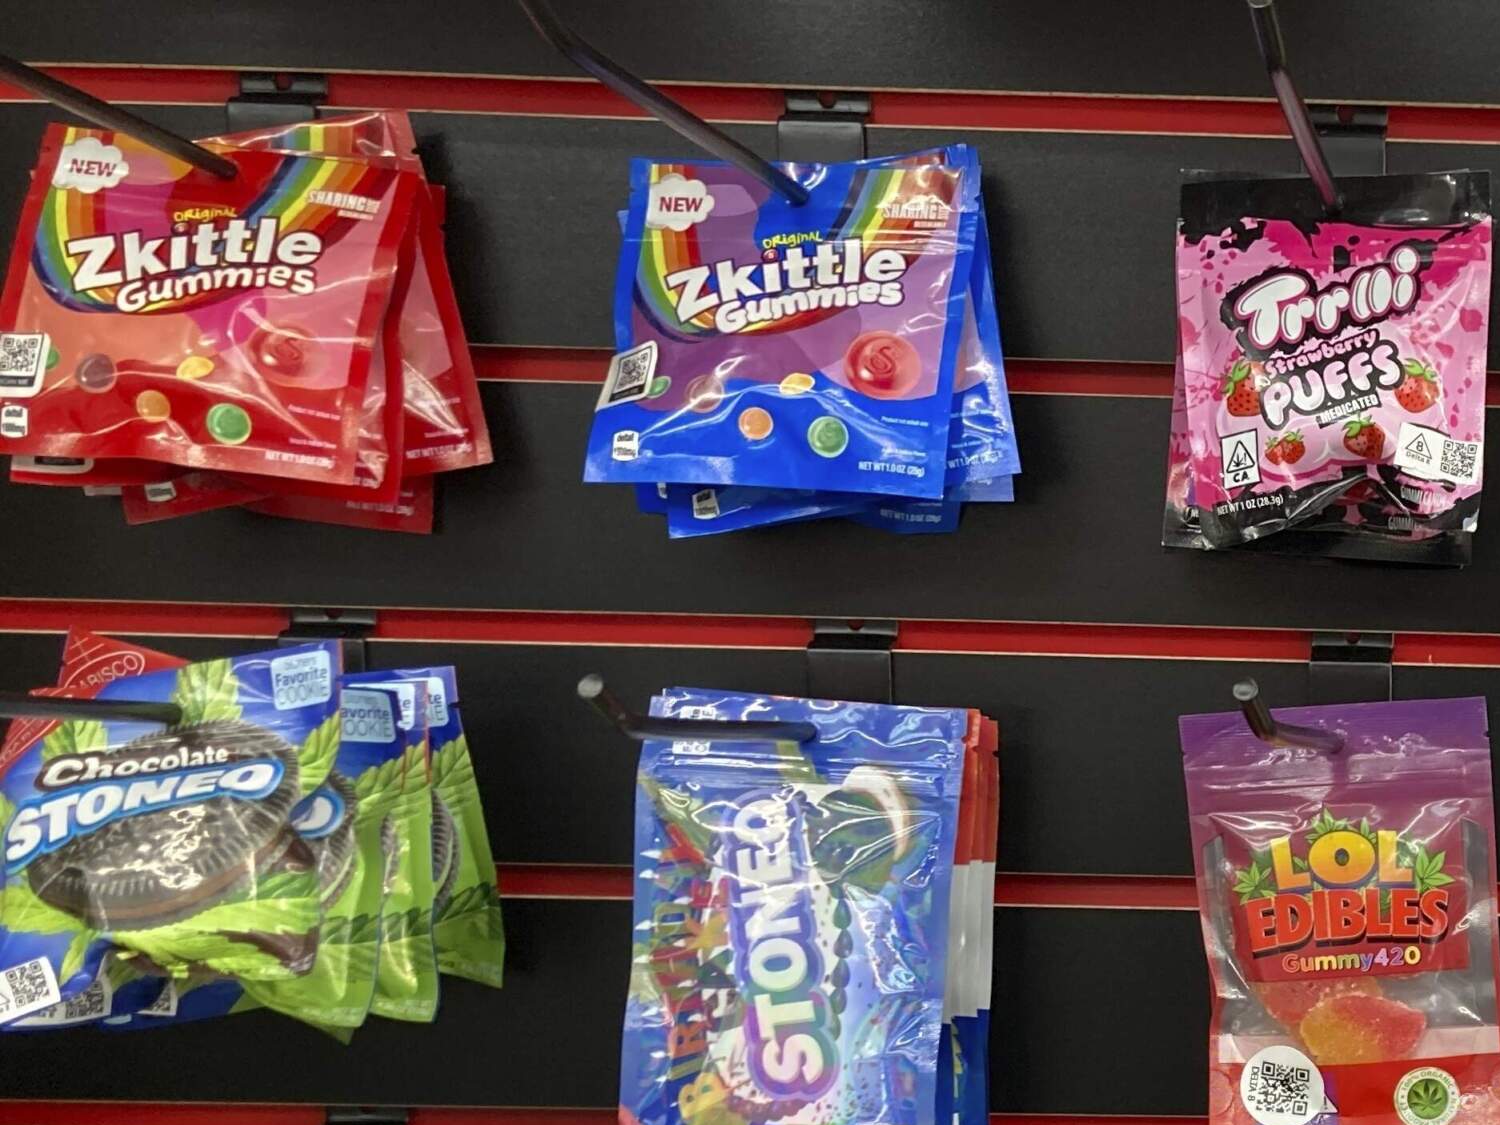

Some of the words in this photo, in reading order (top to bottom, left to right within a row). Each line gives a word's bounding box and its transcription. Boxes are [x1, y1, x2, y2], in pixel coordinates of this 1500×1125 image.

[70, 159, 117, 176] NEW
[659, 197, 704, 213] NEW
[67, 217, 322, 292] Zkittle
[116, 265, 317, 313] Gummies
[667, 239, 906, 324] Zkittle
[714, 281, 903, 335] Gummies
[1265, 329, 1378, 379] Strawberry
[1262, 343, 1404, 427] PUFFS
[1319, 394, 1379, 425] MEDICATED
[1232, 471, 1250, 483] CA
[275, 667, 327, 687] Favorite
[341, 707, 389, 719] avorite
[42, 746, 229, 787] Chocolate
[5, 763, 277, 861] STONEO
[1270, 829, 1414, 891] LOL
[734, 797, 824, 1085] STONEO
[1248, 889, 1449, 954] EDIBLES
